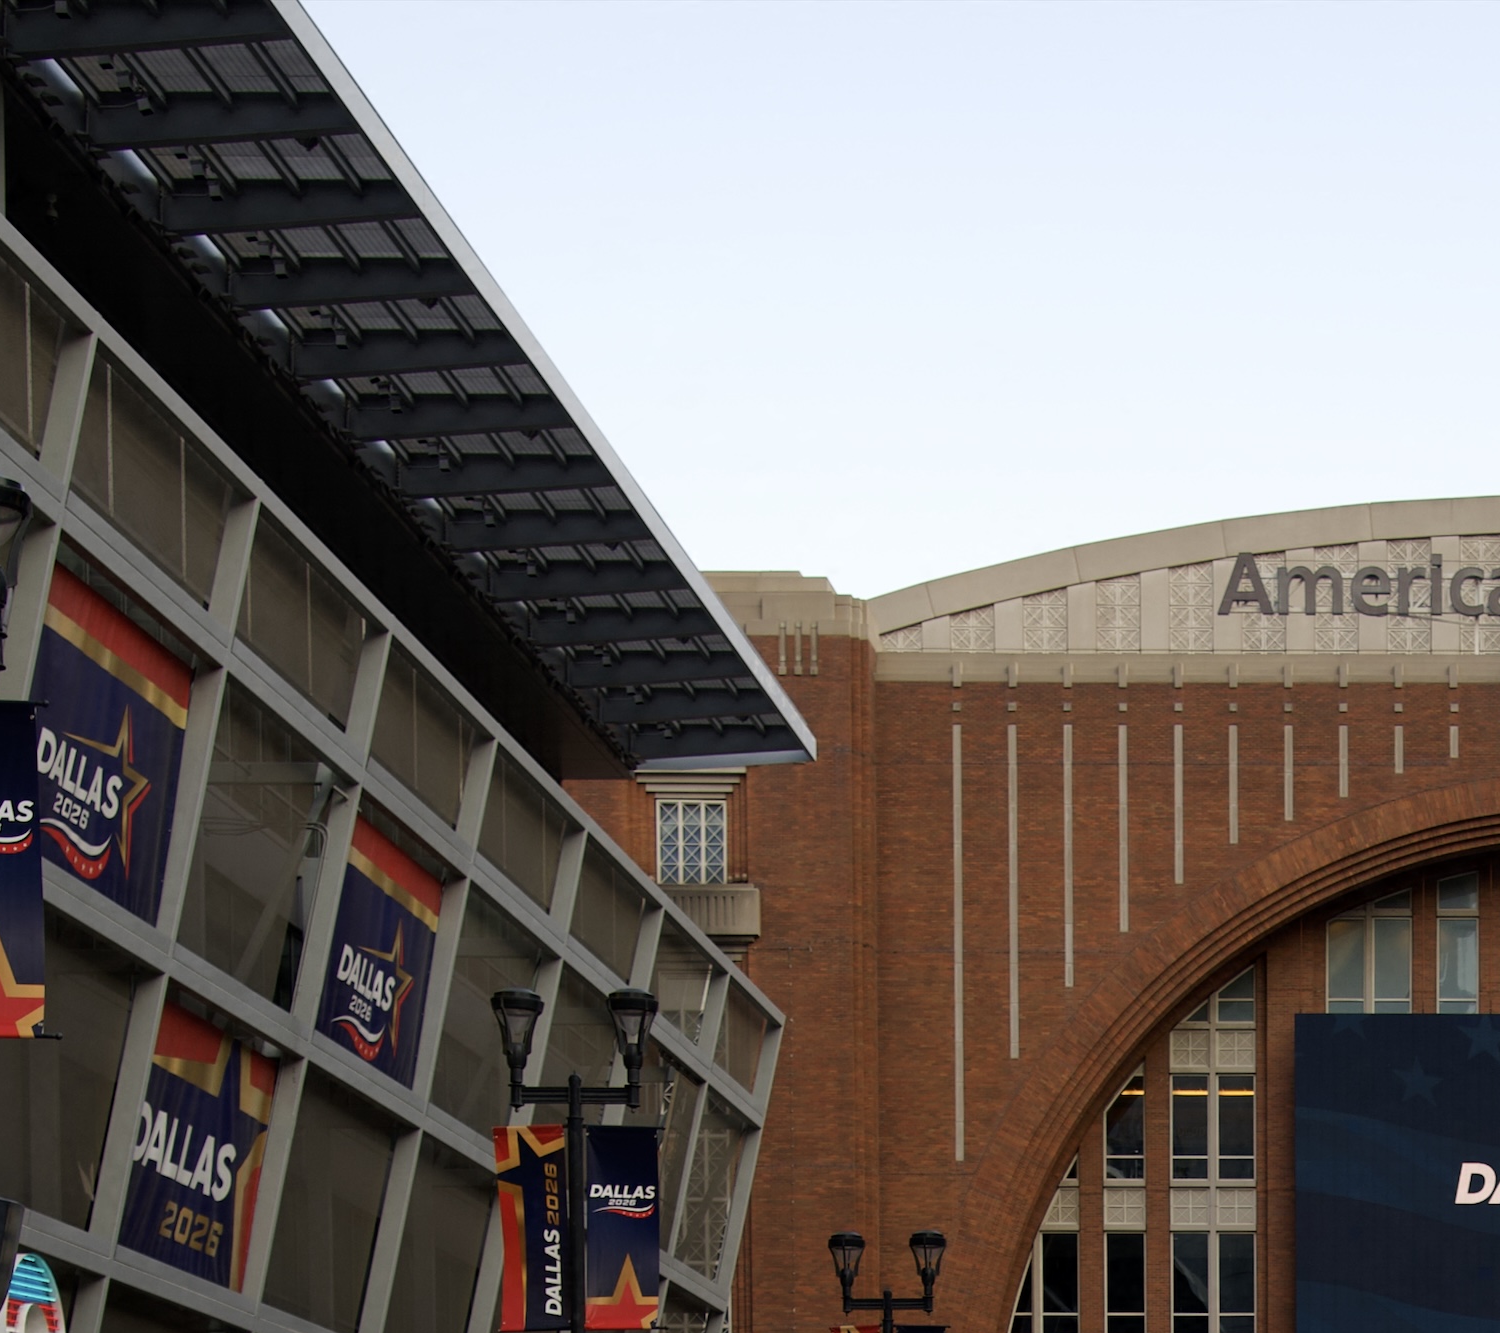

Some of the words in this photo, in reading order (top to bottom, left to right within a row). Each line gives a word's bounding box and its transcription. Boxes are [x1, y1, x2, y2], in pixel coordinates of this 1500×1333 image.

[36, 726, 122, 820] DALLAS
[52, 792, 90, 830] 2026
[335, 943, 397, 1013] DALLAS
[347, 993, 374, 1023] 2026
[132, 1101, 238, 1202] DALLAS
[546, 1162, 559, 1226] 2026
[589, 1183, 656, 1200] DALLAS
[608, 1198, 638, 1207] 2026
[158, 1200, 224, 1258] 2026
[543, 1228, 564, 1316] DALLAS
